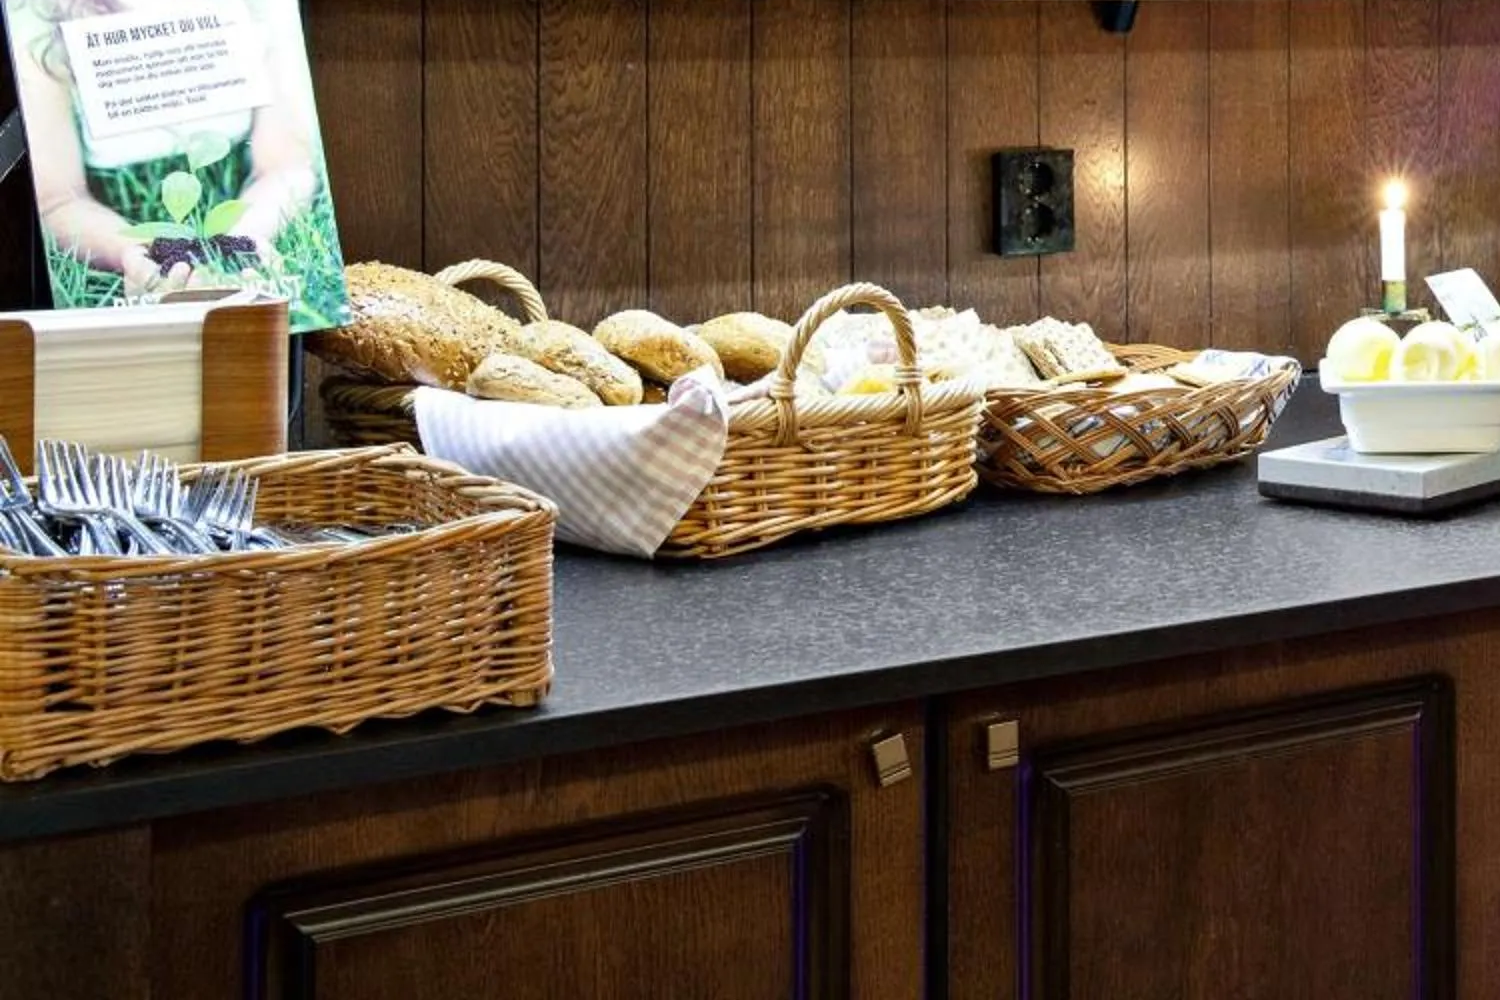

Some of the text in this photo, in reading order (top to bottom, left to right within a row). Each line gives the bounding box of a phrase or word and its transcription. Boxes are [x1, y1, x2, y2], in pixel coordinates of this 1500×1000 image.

[103, 29, 128, 46] HUR
[129, 21, 176, 41] MYCKET
[179, 19, 195, 33] DU
[196, 15, 221, 29] VILL
